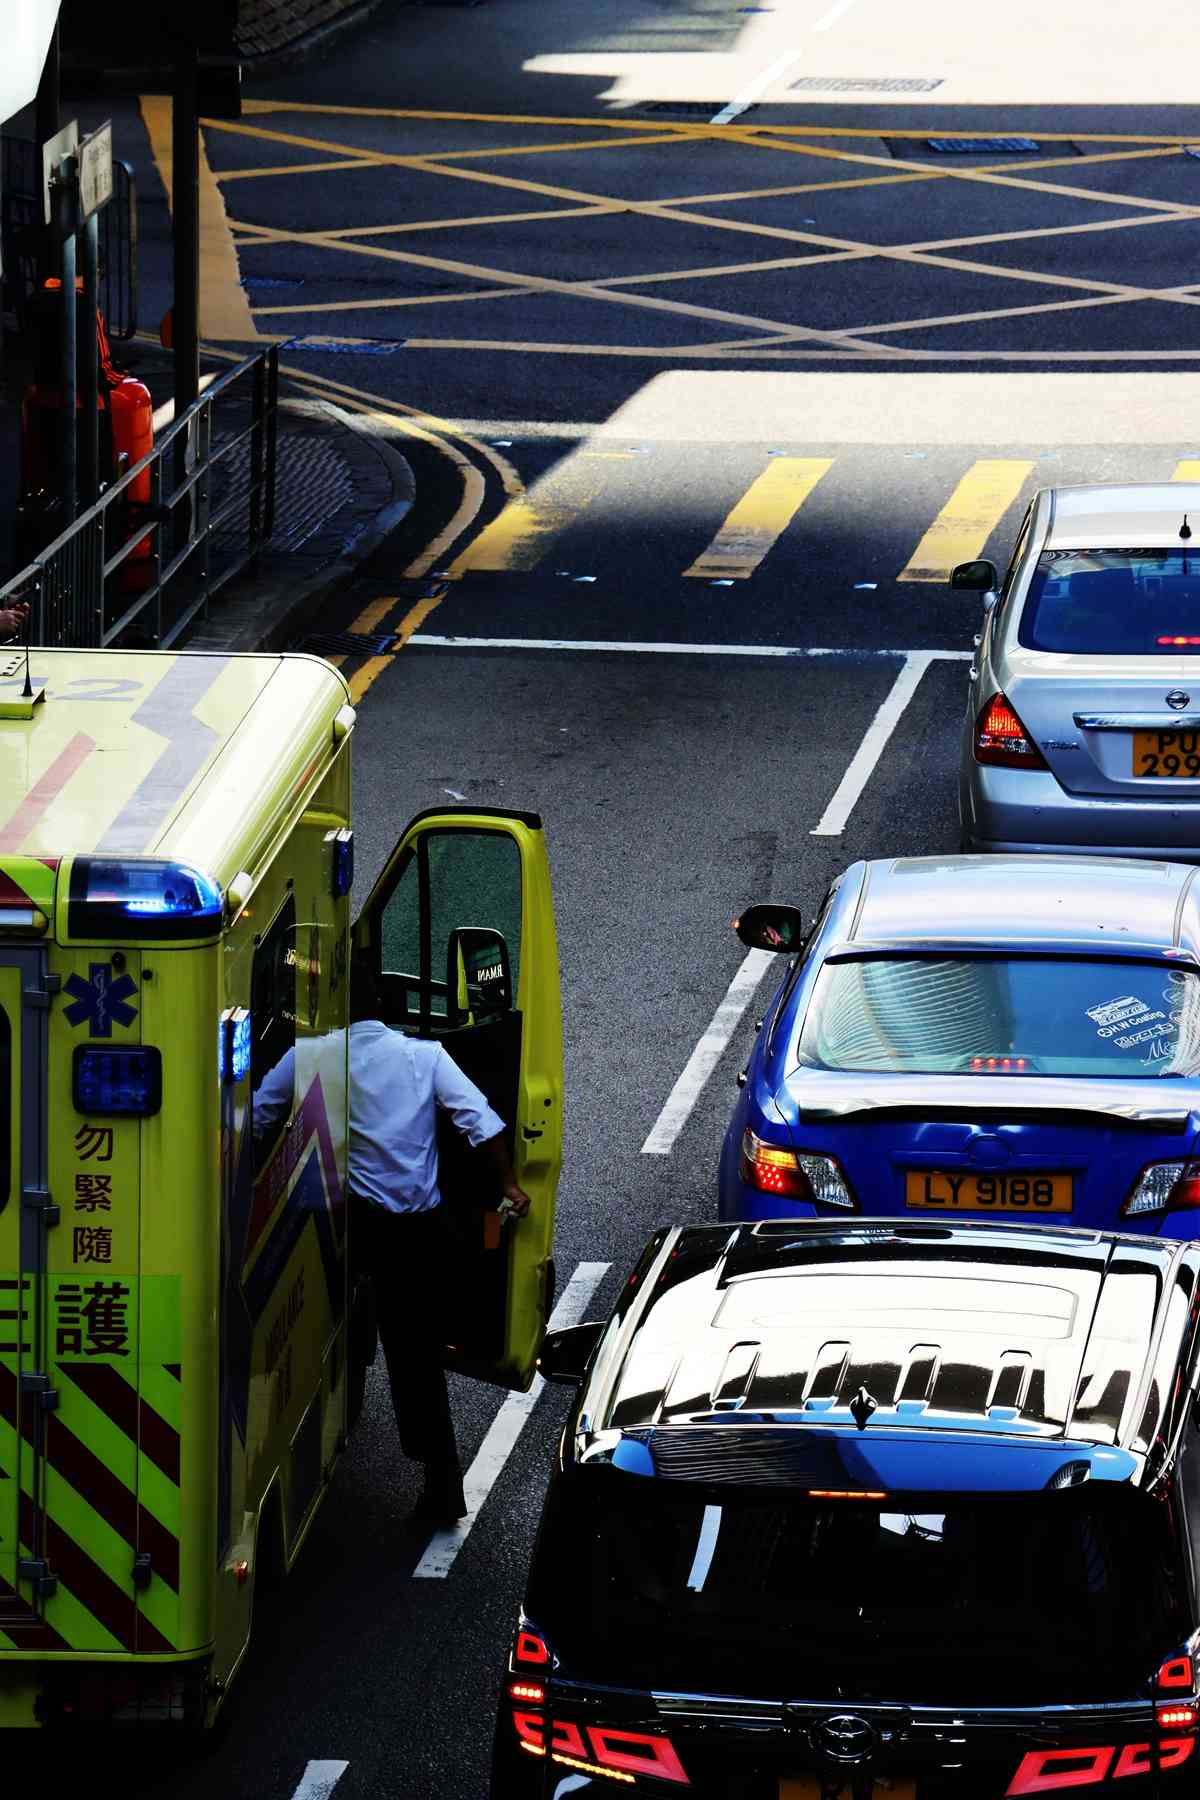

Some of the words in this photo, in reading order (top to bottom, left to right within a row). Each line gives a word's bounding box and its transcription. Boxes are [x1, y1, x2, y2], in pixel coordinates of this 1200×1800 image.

[1157, 732, 1197, 754] PU
[72, 1123, 113, 1264] 勿緊隨
[924, 1175, 964, 1205] LY
[975, 1176, 1054, 1207] 9188
